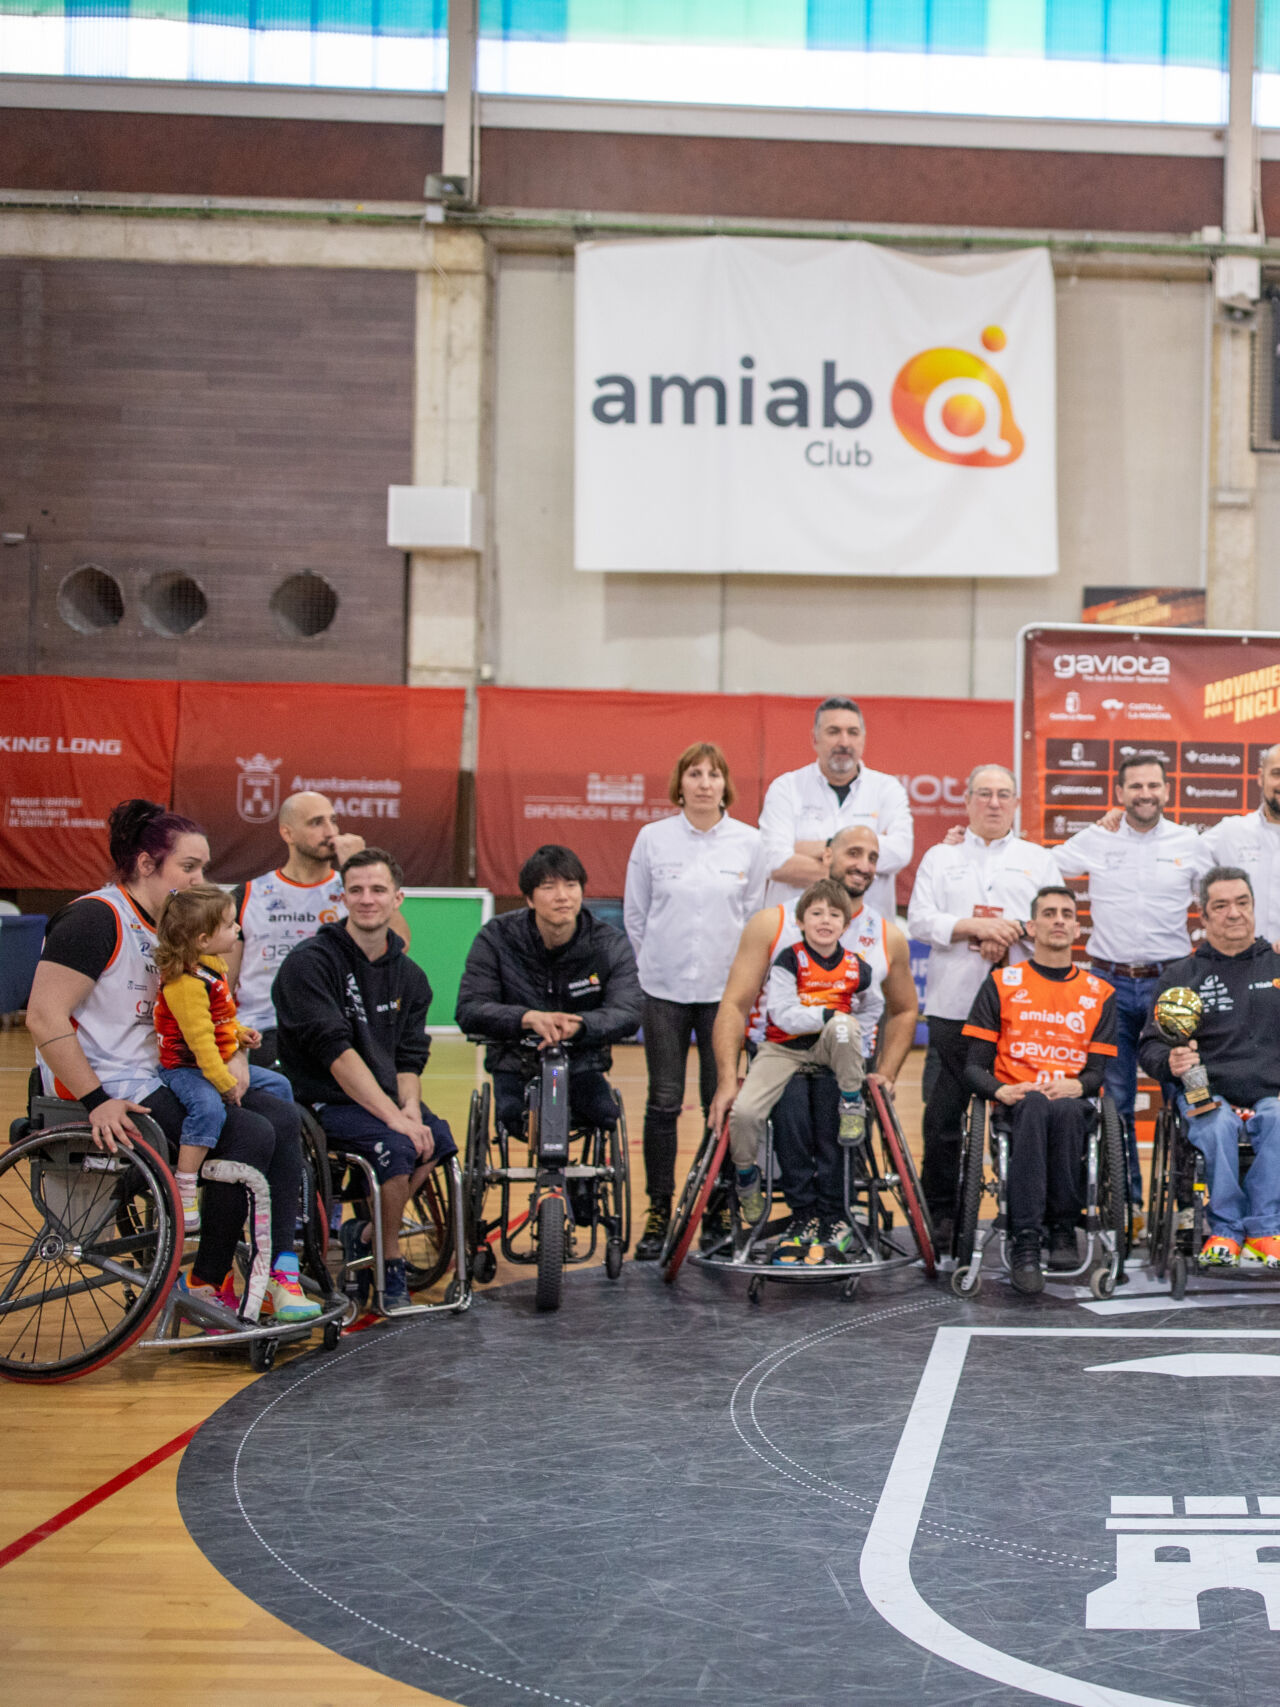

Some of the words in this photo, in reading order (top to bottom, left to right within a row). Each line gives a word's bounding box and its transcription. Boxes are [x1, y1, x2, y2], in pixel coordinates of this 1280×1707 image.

[591, 355, 873, 429] amiab
[804, 440, 873, 468] Club
[1053, 654, 1171, 679] gaviota
[0, 736, 51, 753] KING
[56, 736, 122, 756] LONG
[291, 775, 401, 795] Ayuntamiento
[333, 797, 401, 818] ACETE
[610, 807, 630, 821] DE
[268, 912, 316, 923] amiab
[1020, 1009, 1066, 1024] amiab
[1010, 1041, 1087, 1063] gaviota
